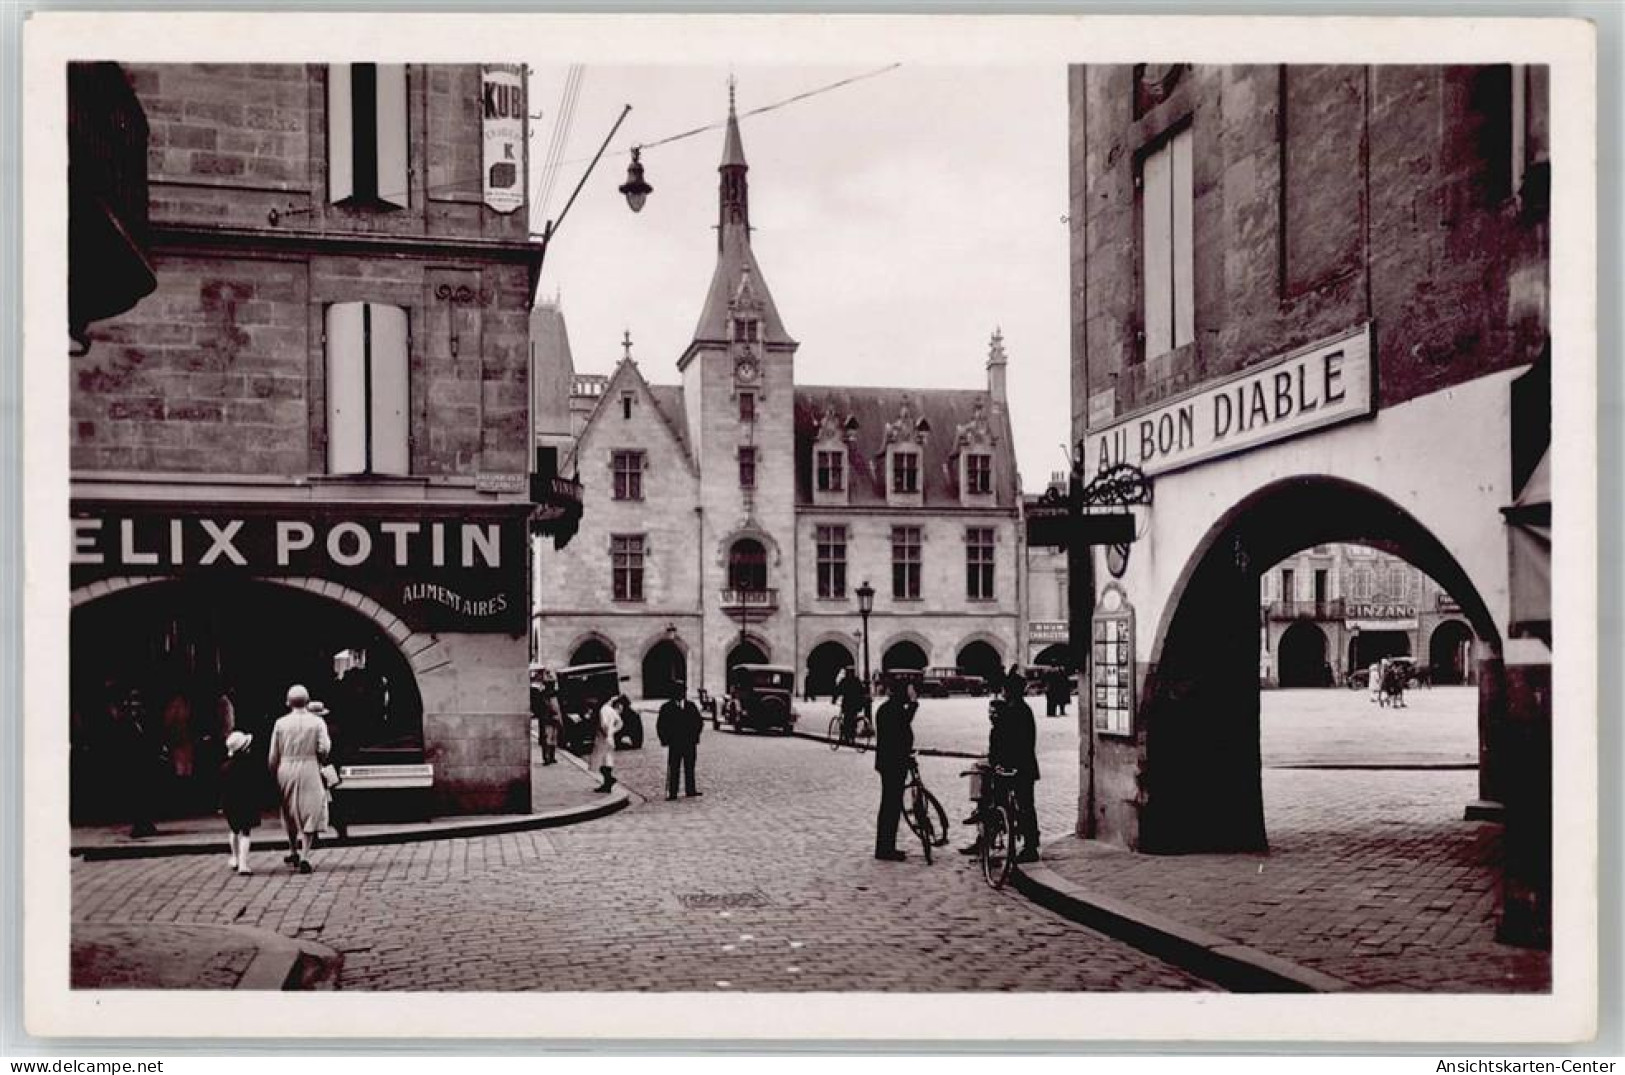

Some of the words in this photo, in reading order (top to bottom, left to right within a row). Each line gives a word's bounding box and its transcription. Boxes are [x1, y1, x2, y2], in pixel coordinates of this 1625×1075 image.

[484, 81, 521, 119] KUB
[504, 143, 515, 159] K
[1099, 427, 1127, 470] AU
[1140, 404, 1195, 463] BON
[1214, 350, 1347, 438] DIABLE
[275, 520, 501, 568] POTIN
[402, 583, 508, 617] ALIMENTAIRES
[1345, 603, 1417, 618] CINZANO
